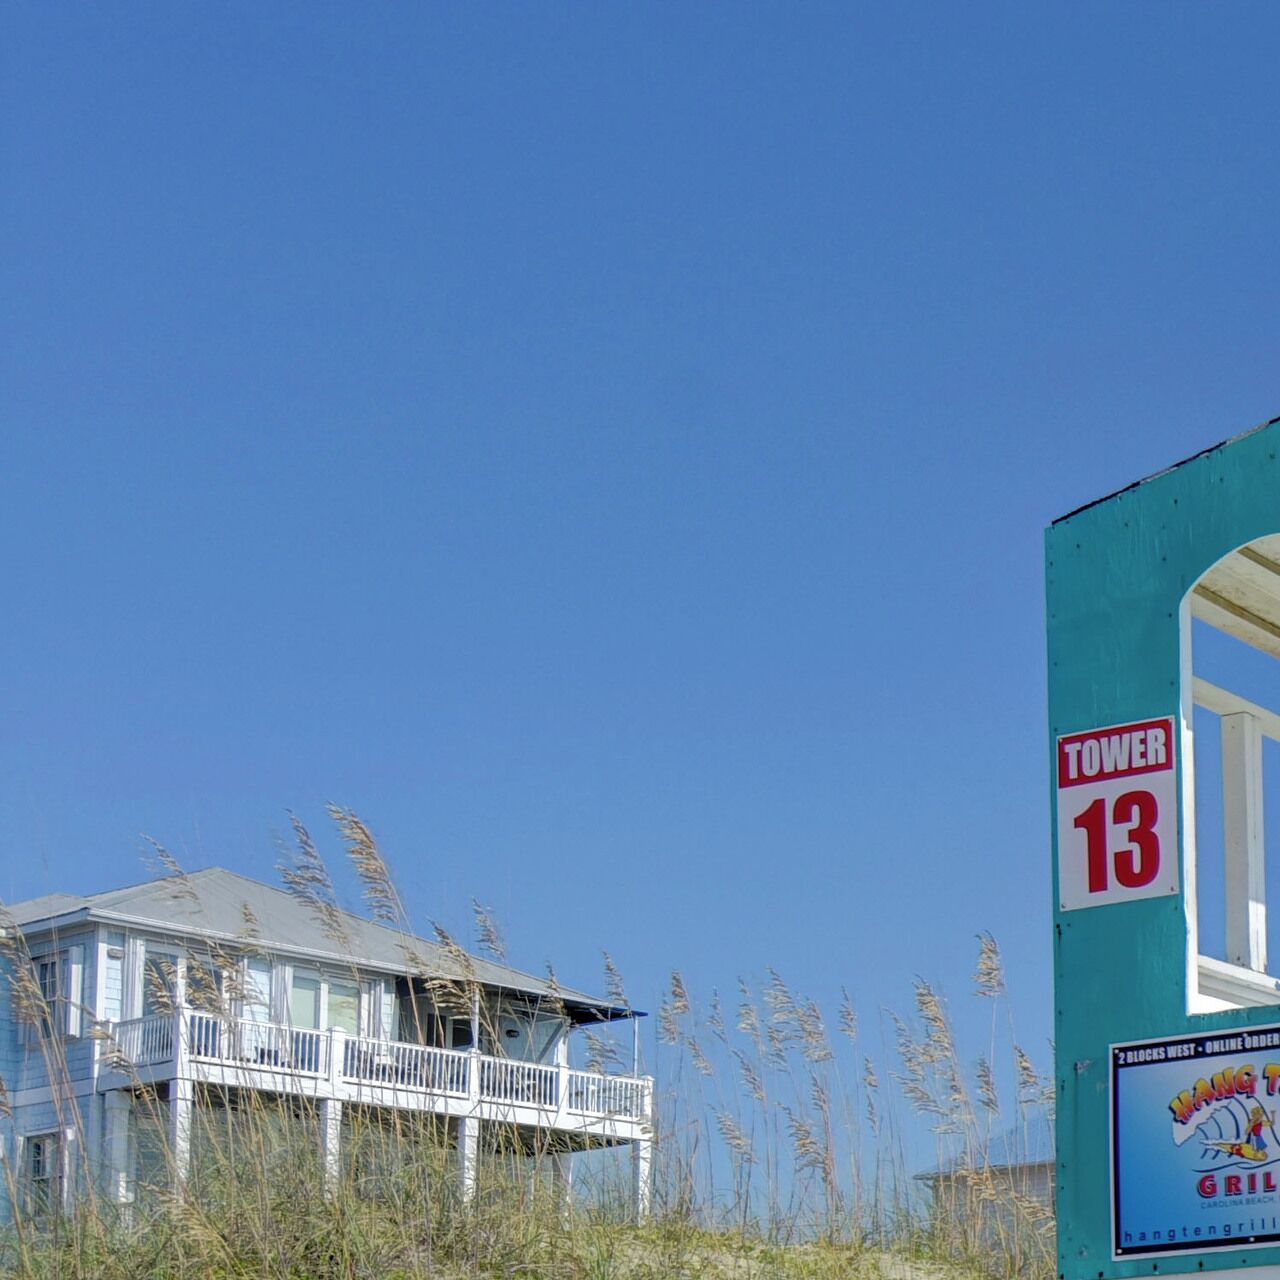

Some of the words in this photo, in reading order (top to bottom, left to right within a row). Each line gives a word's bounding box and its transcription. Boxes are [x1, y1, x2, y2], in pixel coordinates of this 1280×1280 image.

[1064, 727, 1166, 780] TOWER
[1073, 790, 1160, 894] 13
[1118, 1052, 1126, 1065] 2
[1126, 1047, 1166, 1064] BLOCKS
[1166, 1043, 1196, 1059] WEST
[1205, 1037, 1243, 1054] ONLINE
[1168, 1063, 1258, 1125] HANG
[1200, 1198, 1244, 1210] CAROLINA
